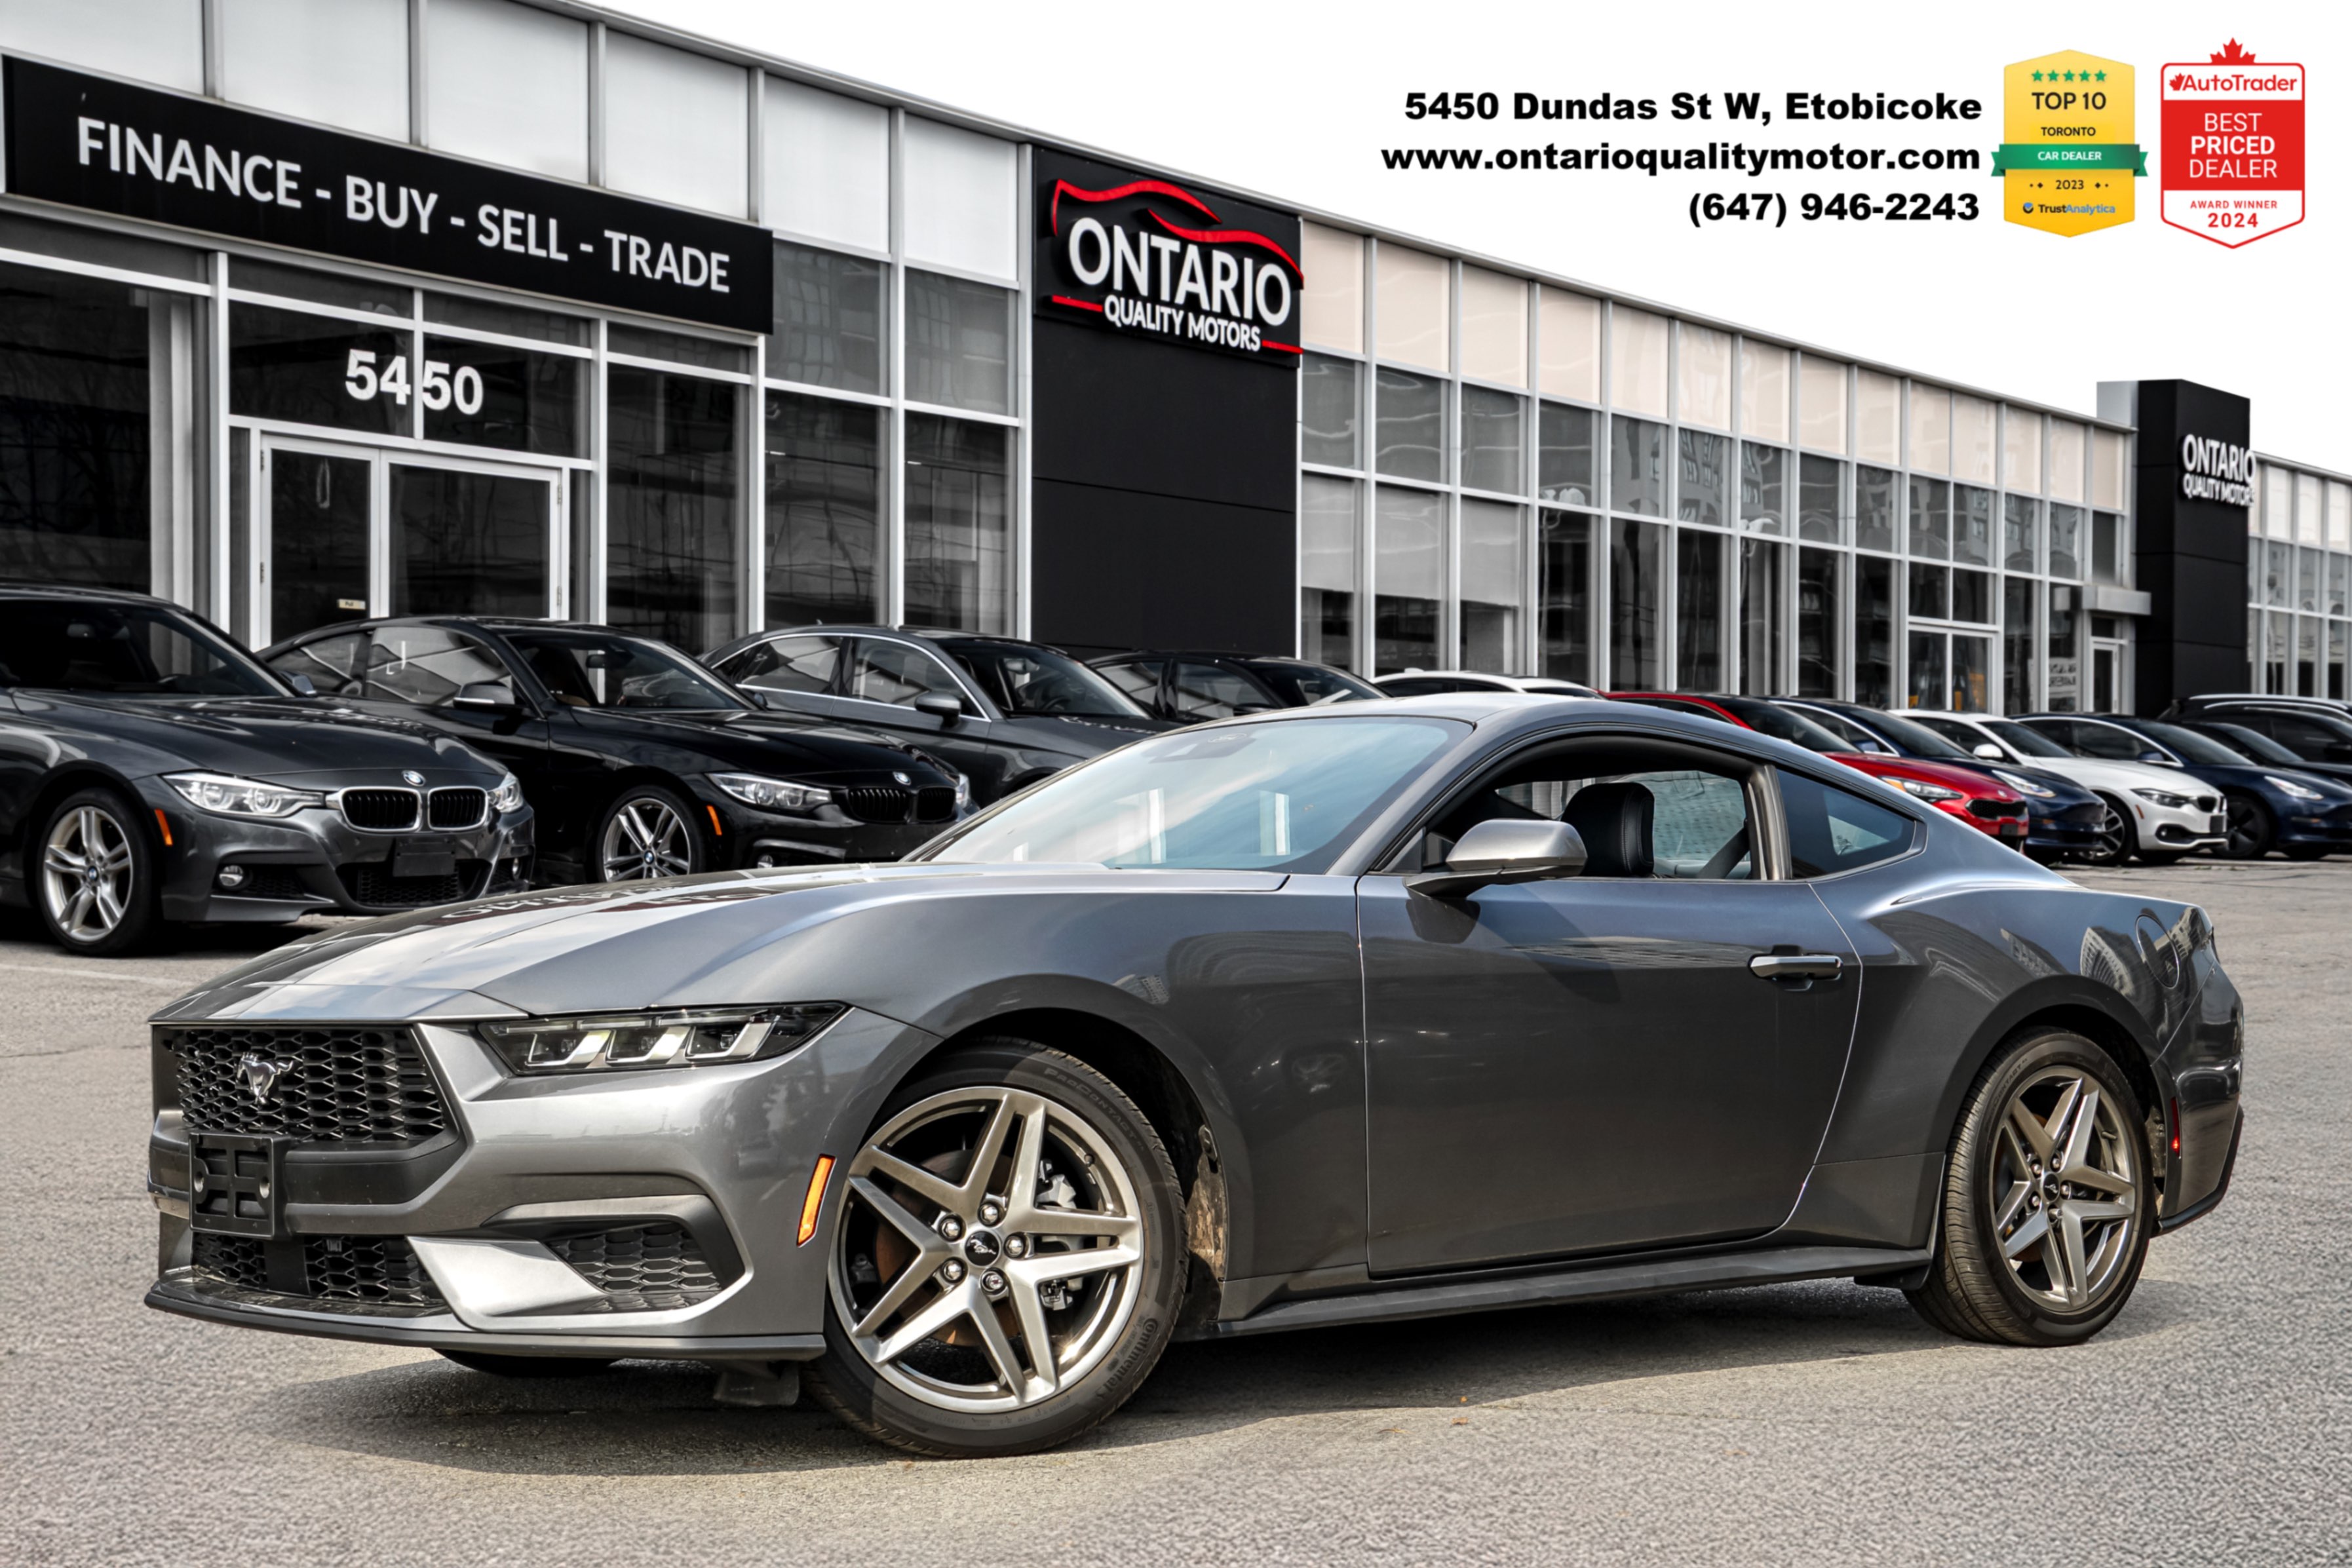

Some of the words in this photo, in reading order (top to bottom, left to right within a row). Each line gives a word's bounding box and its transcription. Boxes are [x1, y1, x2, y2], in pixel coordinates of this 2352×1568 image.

[77, 117, 301, 209] FINANCE
[345, 174, 438, 234] BUY
[478, 204, 568, 262] SELL
[604, 229, 730, 294] TRADE
[1069, 217, 1292, 326] ONTARIO
[1104, 296, 1185, 335] QUALITY
[1187, 312, 1261, 352] MOTORS
[345, 349, 484, 416] 5450
[2182, 434, 2256, 484] ONTARIO
[2183, 473, 2220, 501] QUALITY
[1102, 1317, 1159, 1393] Continental
